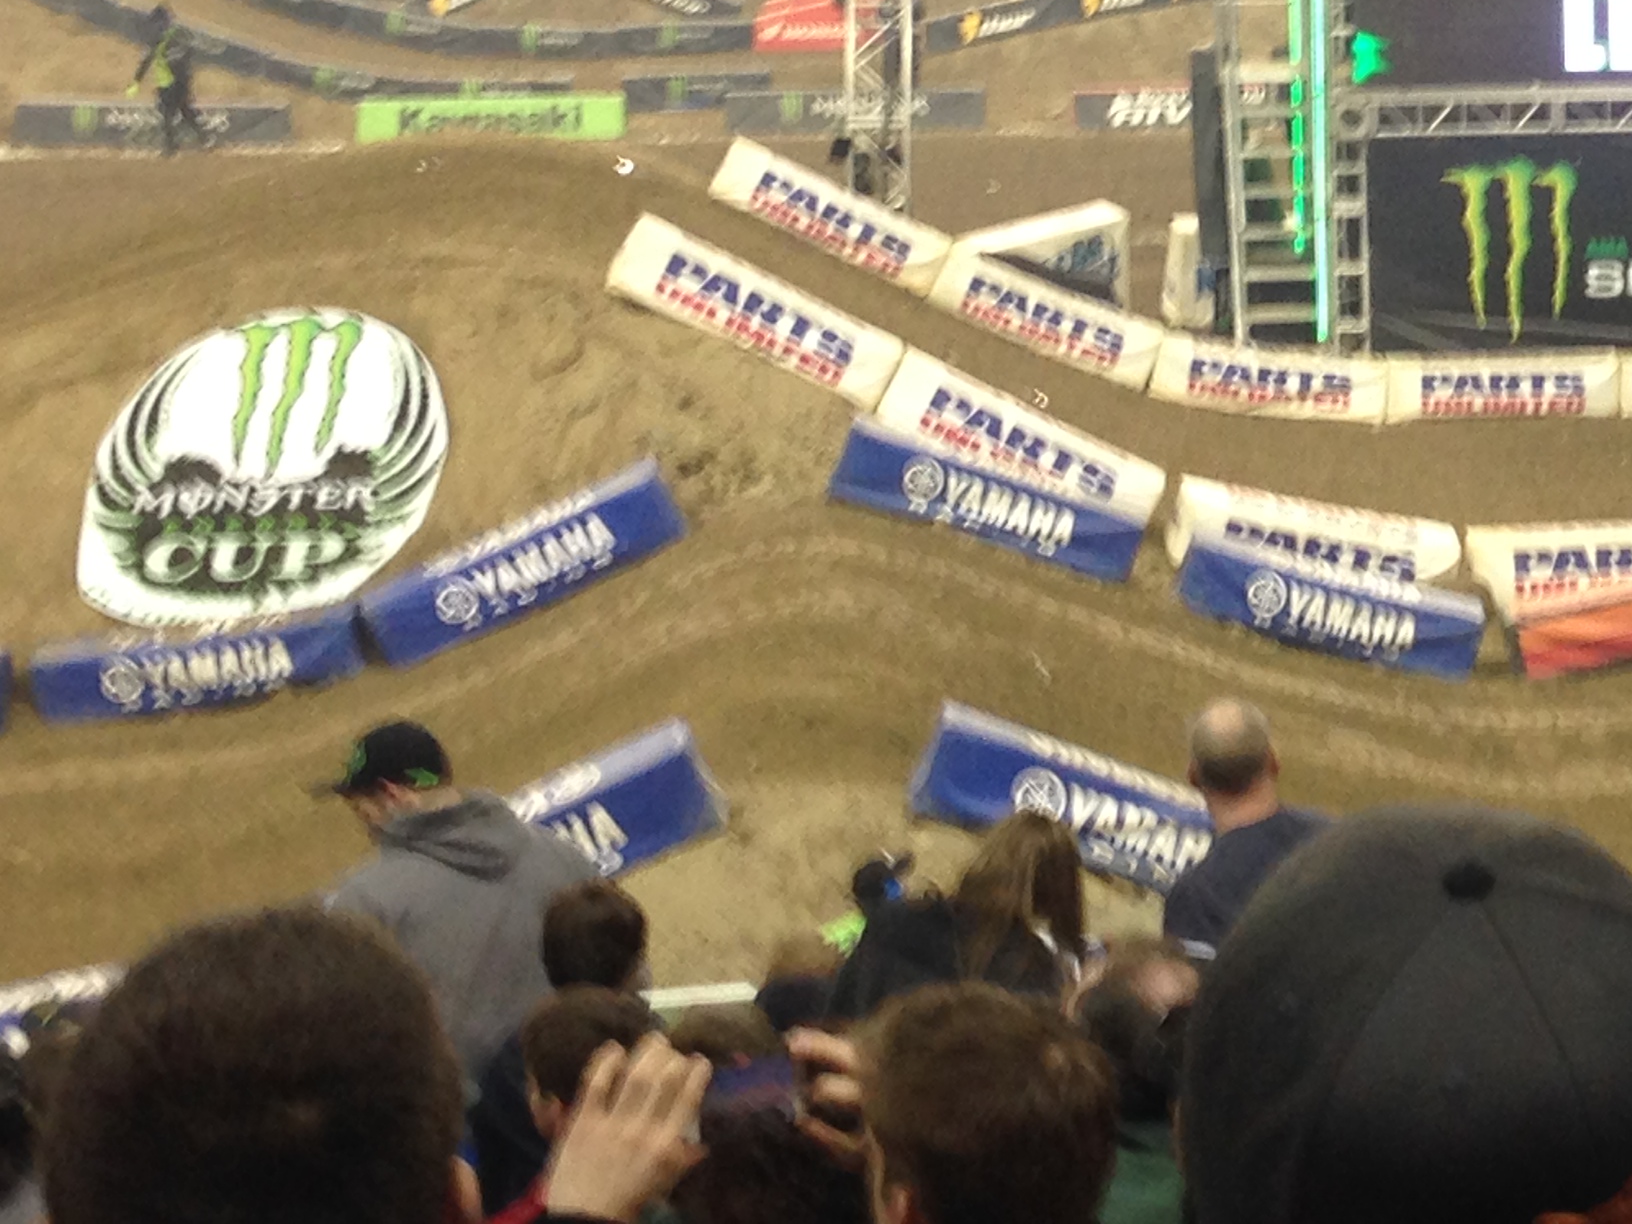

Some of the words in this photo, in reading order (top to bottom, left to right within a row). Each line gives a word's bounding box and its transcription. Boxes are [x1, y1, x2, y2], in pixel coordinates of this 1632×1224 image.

[130, 475, 379, 519] MONSTER
[946, 468, 1076, 549] YAMAHA
[141, 528, 351, 588] CUP
[465, 511, 619, 600] YAMAHA
[1288, 579, 1417, 652] YAMAHA
[138, 635, 296, 687] YAMAHA
[1068, 781, 1214, 876] YAMAH
